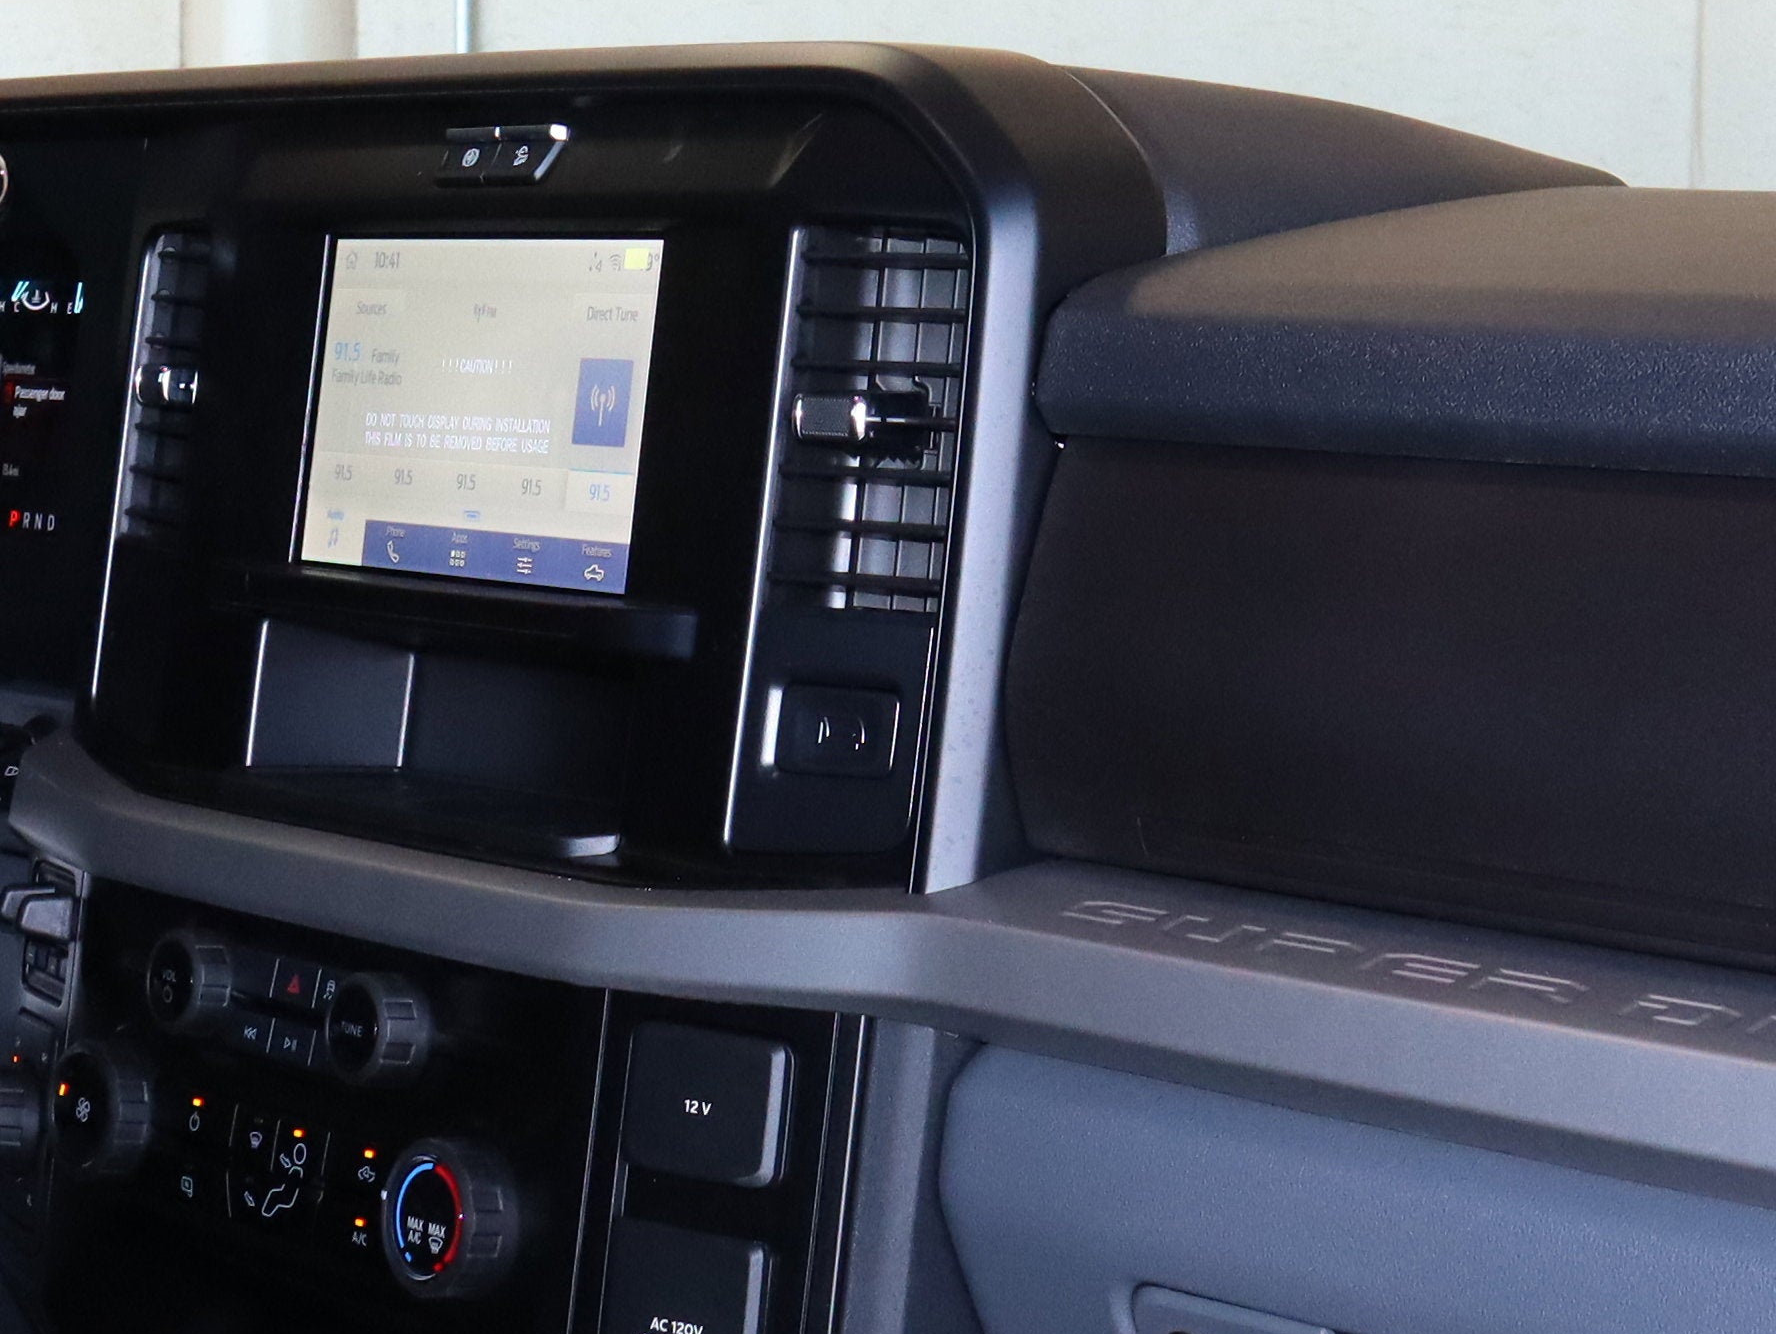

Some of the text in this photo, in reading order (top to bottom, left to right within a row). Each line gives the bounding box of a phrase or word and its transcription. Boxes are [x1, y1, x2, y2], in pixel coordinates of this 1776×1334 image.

[374, 251, 401, 268] 10:41
[586, 306, 638, 323] Direct Tune
[334, 342, 361, 362] 91.5
[366, 412, 551, 434] DO NOT TOUCH DISPLAY DURING INSTALLATION
[365, 431, 381, 445] THIS
[384, 432, 401, 447] FILM
[416, 434, 426, 448] TO
[429, 435, 441, 449] BE
[444, 436, 482, 451] REMOVED
[486, 438, 517, 452] BEFORE
[521, 439, 550, 454] USAGE
[394, 469, 413, 486] 91.5
[456, 474, 477, 492] 91.5
[521, 478, 542, 497] 91.5
[589, 483, 610, 501] 91.5
[9, 510, 55, 532] P R N D
[512, 537, 541, 553] Settings
[581, 543, 613, 559] Features
[1060, 898, 1591, 1005] SUPER
[340, 1021, 364, 1038] TUNE
[684, 1099, 712, 1116] 12 V
[406, 1215, 425, 1233] MAX
[427, 1222, 447, 1240] MAX
[351, 1230, 368, 1248] A/C
[407, 1229, 422, 1246] A/C
[649, 1316, 670, 1333] AC
